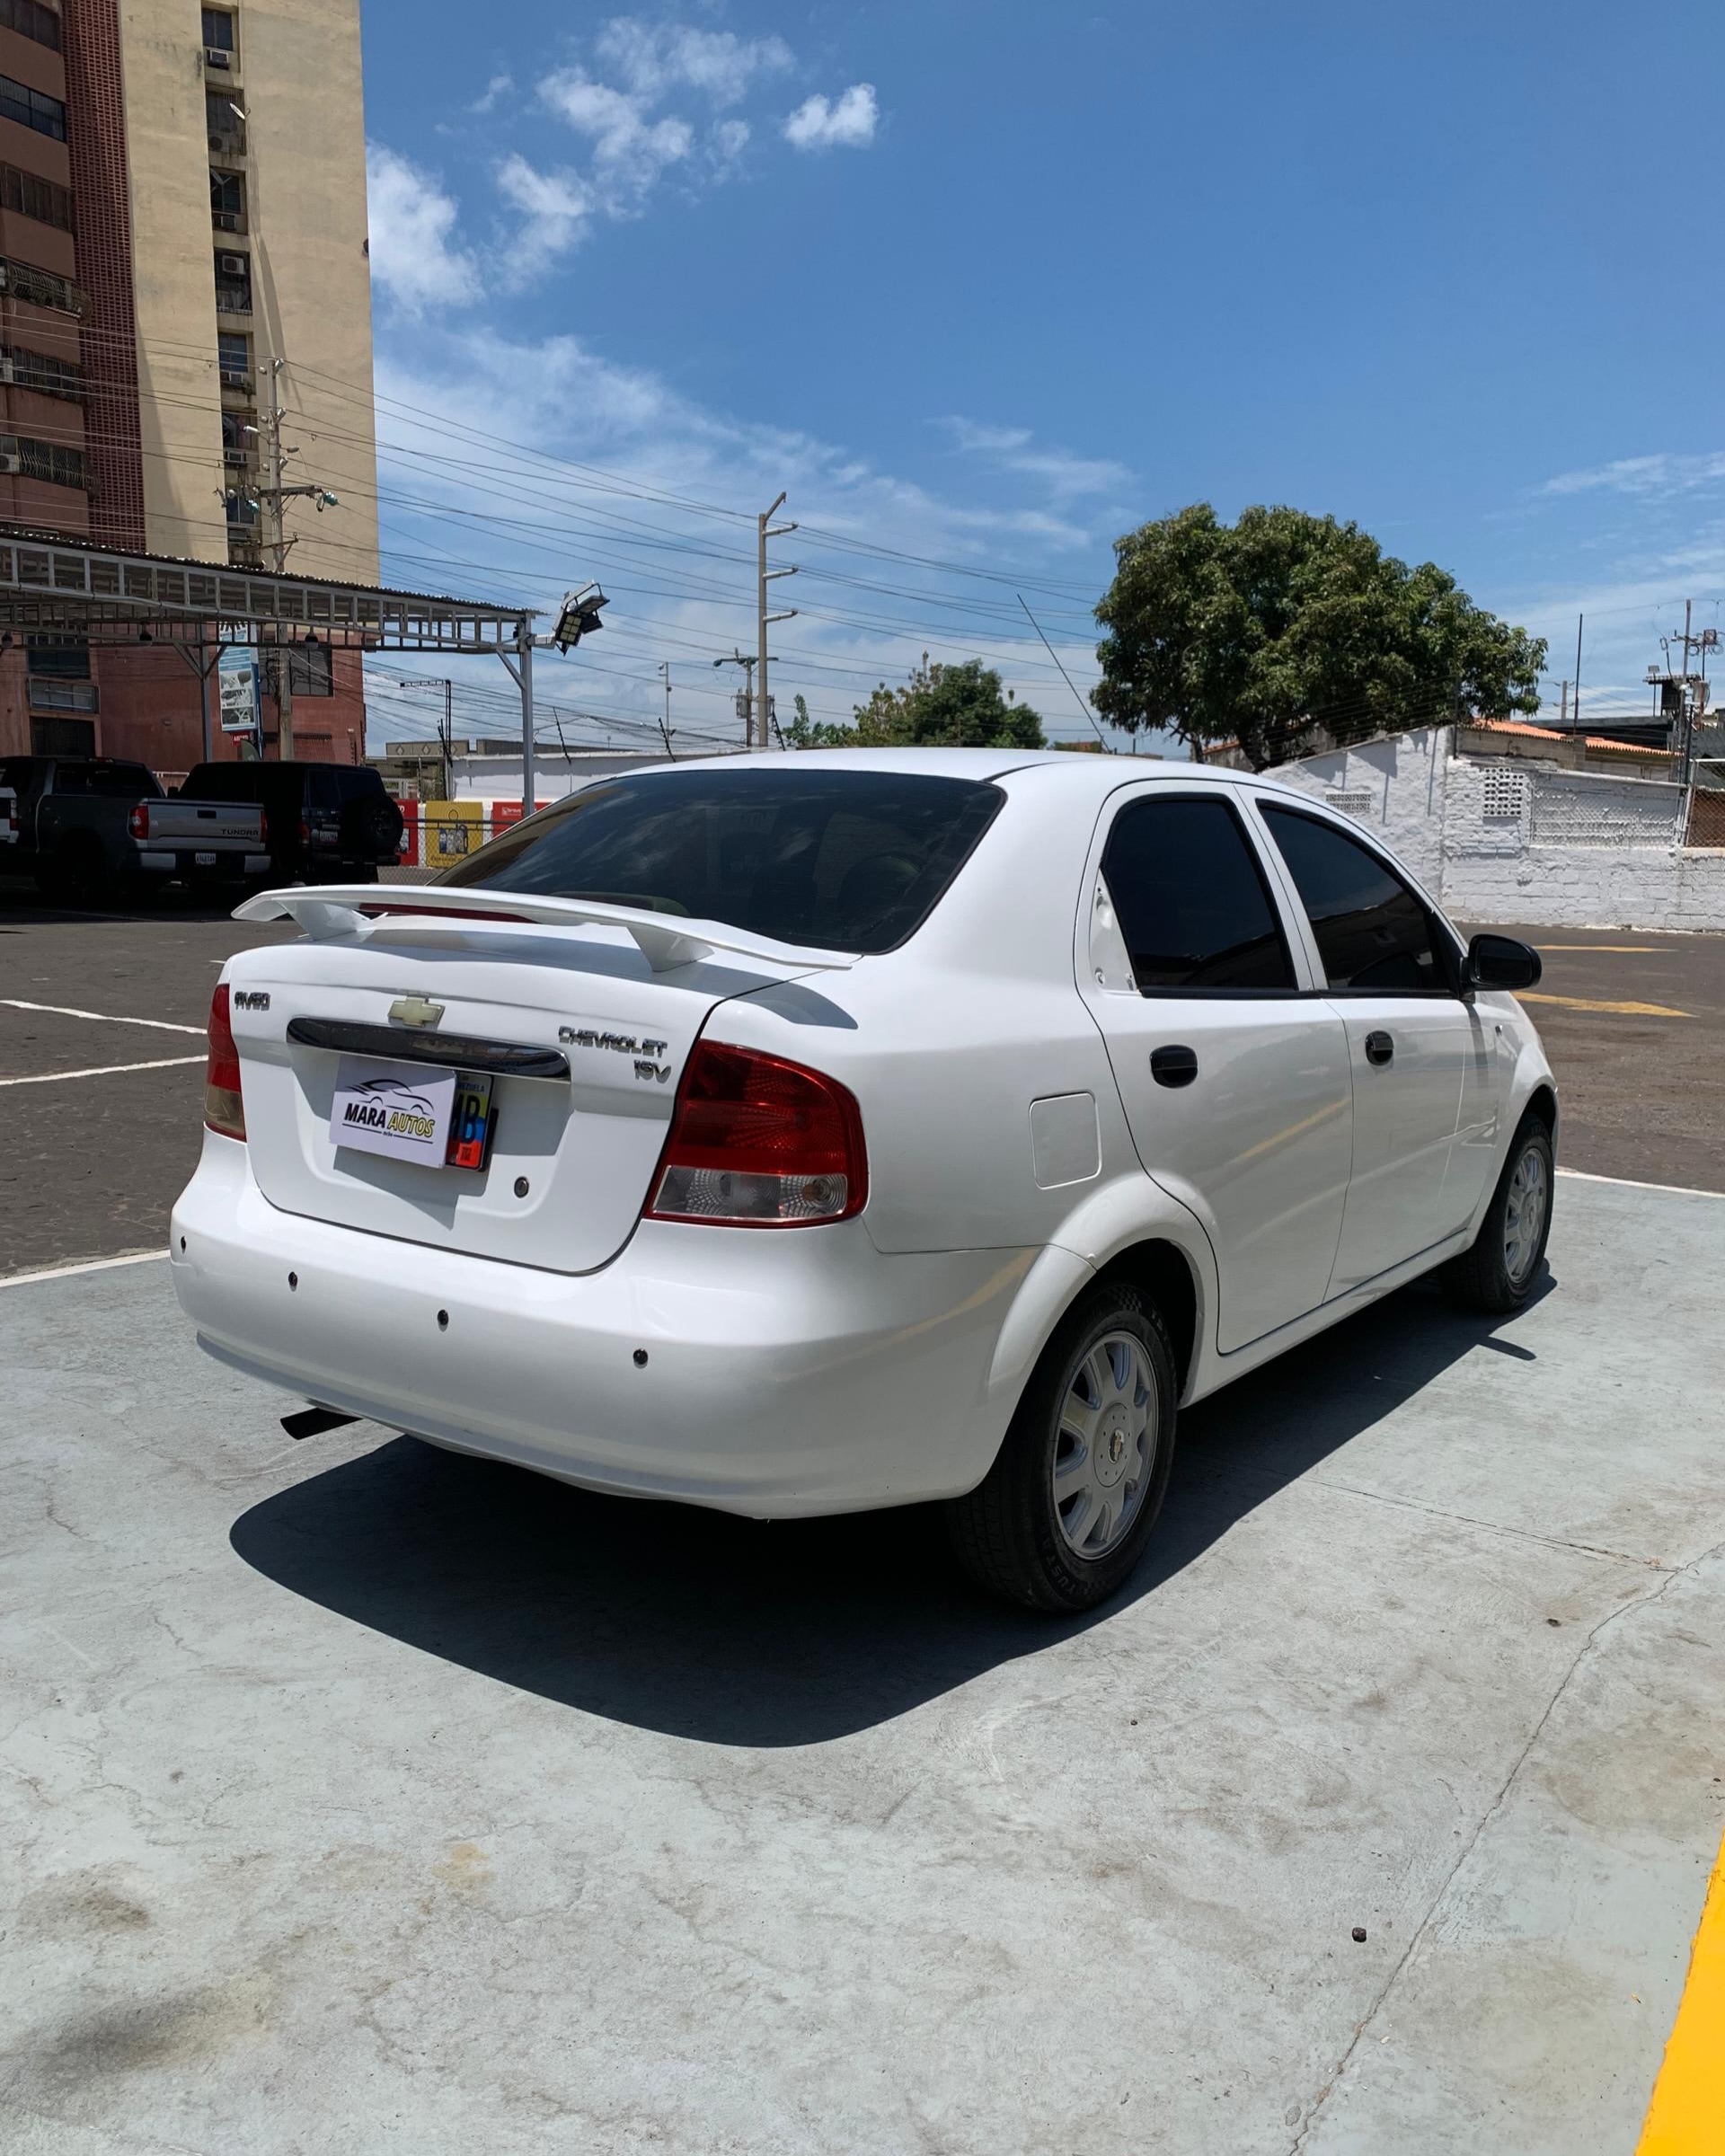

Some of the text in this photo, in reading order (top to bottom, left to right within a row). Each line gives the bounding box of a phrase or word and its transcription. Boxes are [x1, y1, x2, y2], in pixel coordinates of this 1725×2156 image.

[221, 828, 259, 836] TUNDRA
[234, 991, 271, 1012] AVEO
[558, 1025, 668, 1058] CHEVROLET
[633, 1059, 672, 1084] 16V
[344, 1102, 436, 1138] MARA AUTOS
